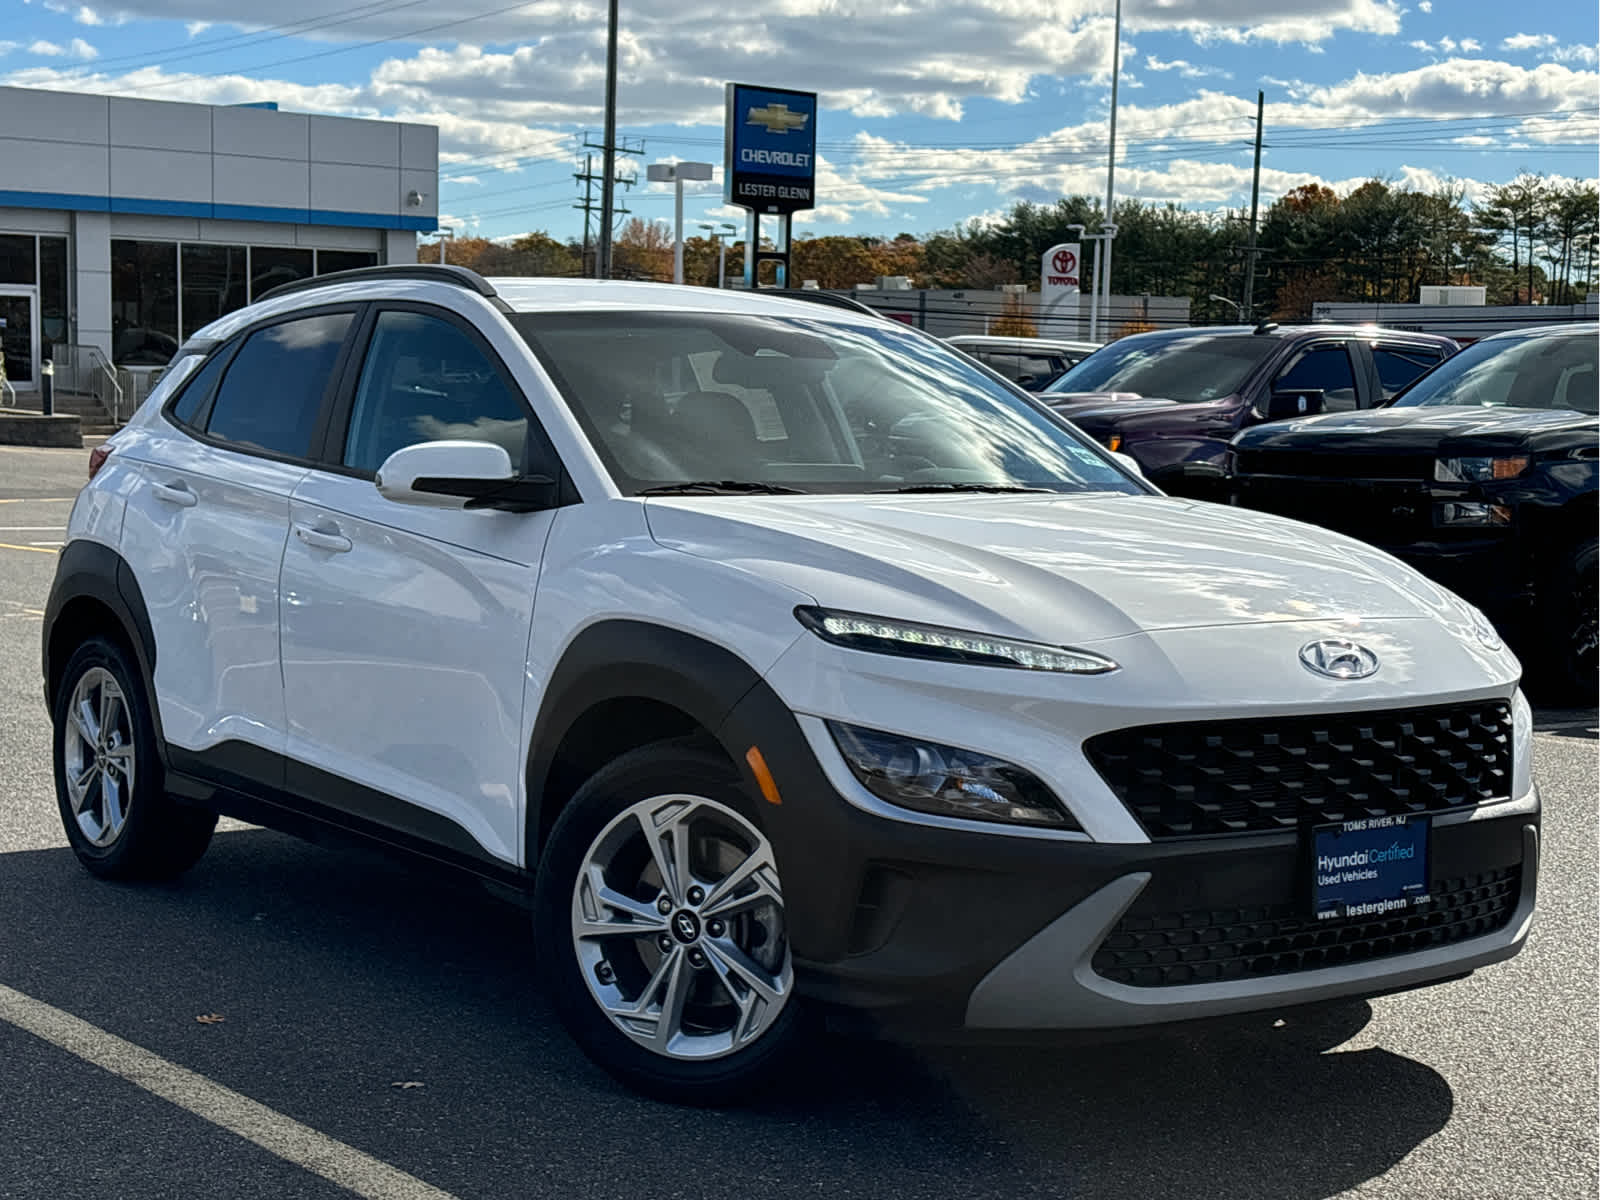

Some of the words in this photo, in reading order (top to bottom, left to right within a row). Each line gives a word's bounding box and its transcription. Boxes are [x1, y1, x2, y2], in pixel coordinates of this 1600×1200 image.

[741, 149, 810, 167] CHEVROLET
[739, 183, 776, 197] LESTER
[778, 187, 810, 200] GLENN
[1048, 276, 1079, 286] TOYOTA
[1343, 821, 1367, 831] TOMS
[1396, 815, 1406, 825] NJ
[1318, 849, 1369, 872] Hyundai
[1369, 842, 1414, 863] Certified
[1318, 872, 1341, 886] Used
[1342, 869, 1378, 882] Vehicles
[1346, 899, 1406, 917] lesterglenn
